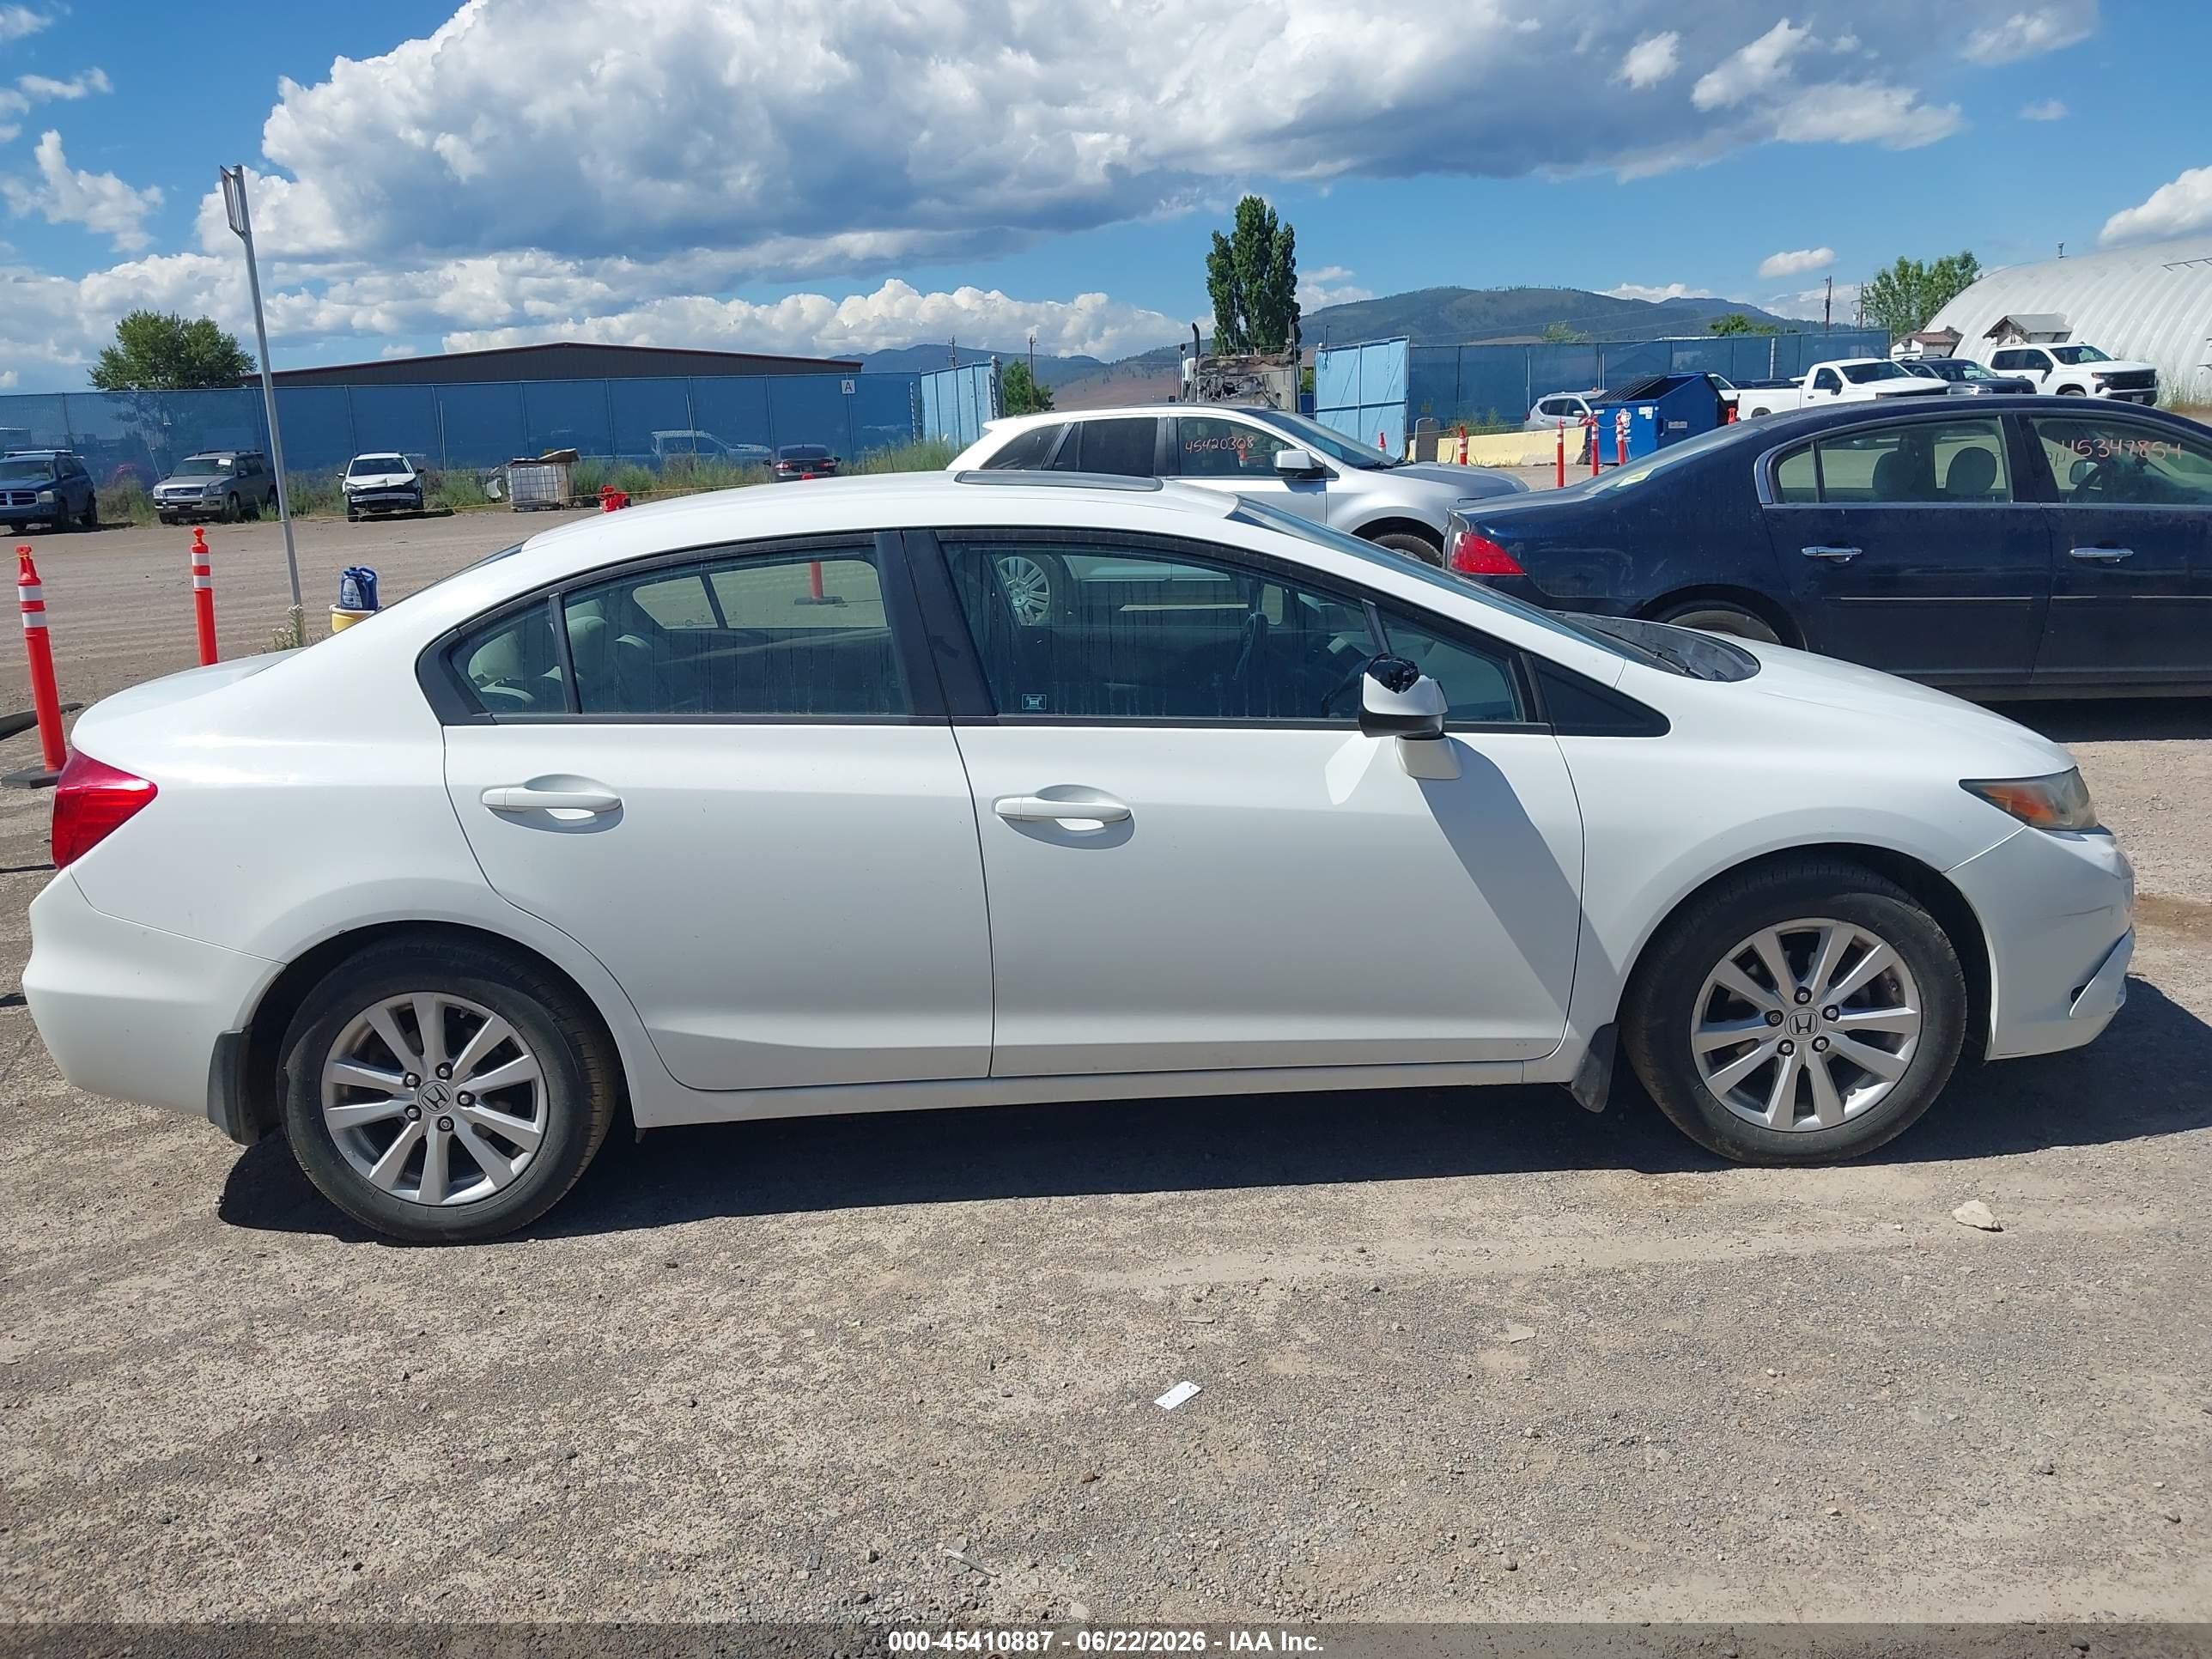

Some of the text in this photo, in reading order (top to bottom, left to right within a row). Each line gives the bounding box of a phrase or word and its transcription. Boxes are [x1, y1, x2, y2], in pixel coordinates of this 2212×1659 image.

[844, 380, 853, 392] A
[1185, 435, 1255, 453] 45420308
[2062, 439, 2181, 460] 45347854
